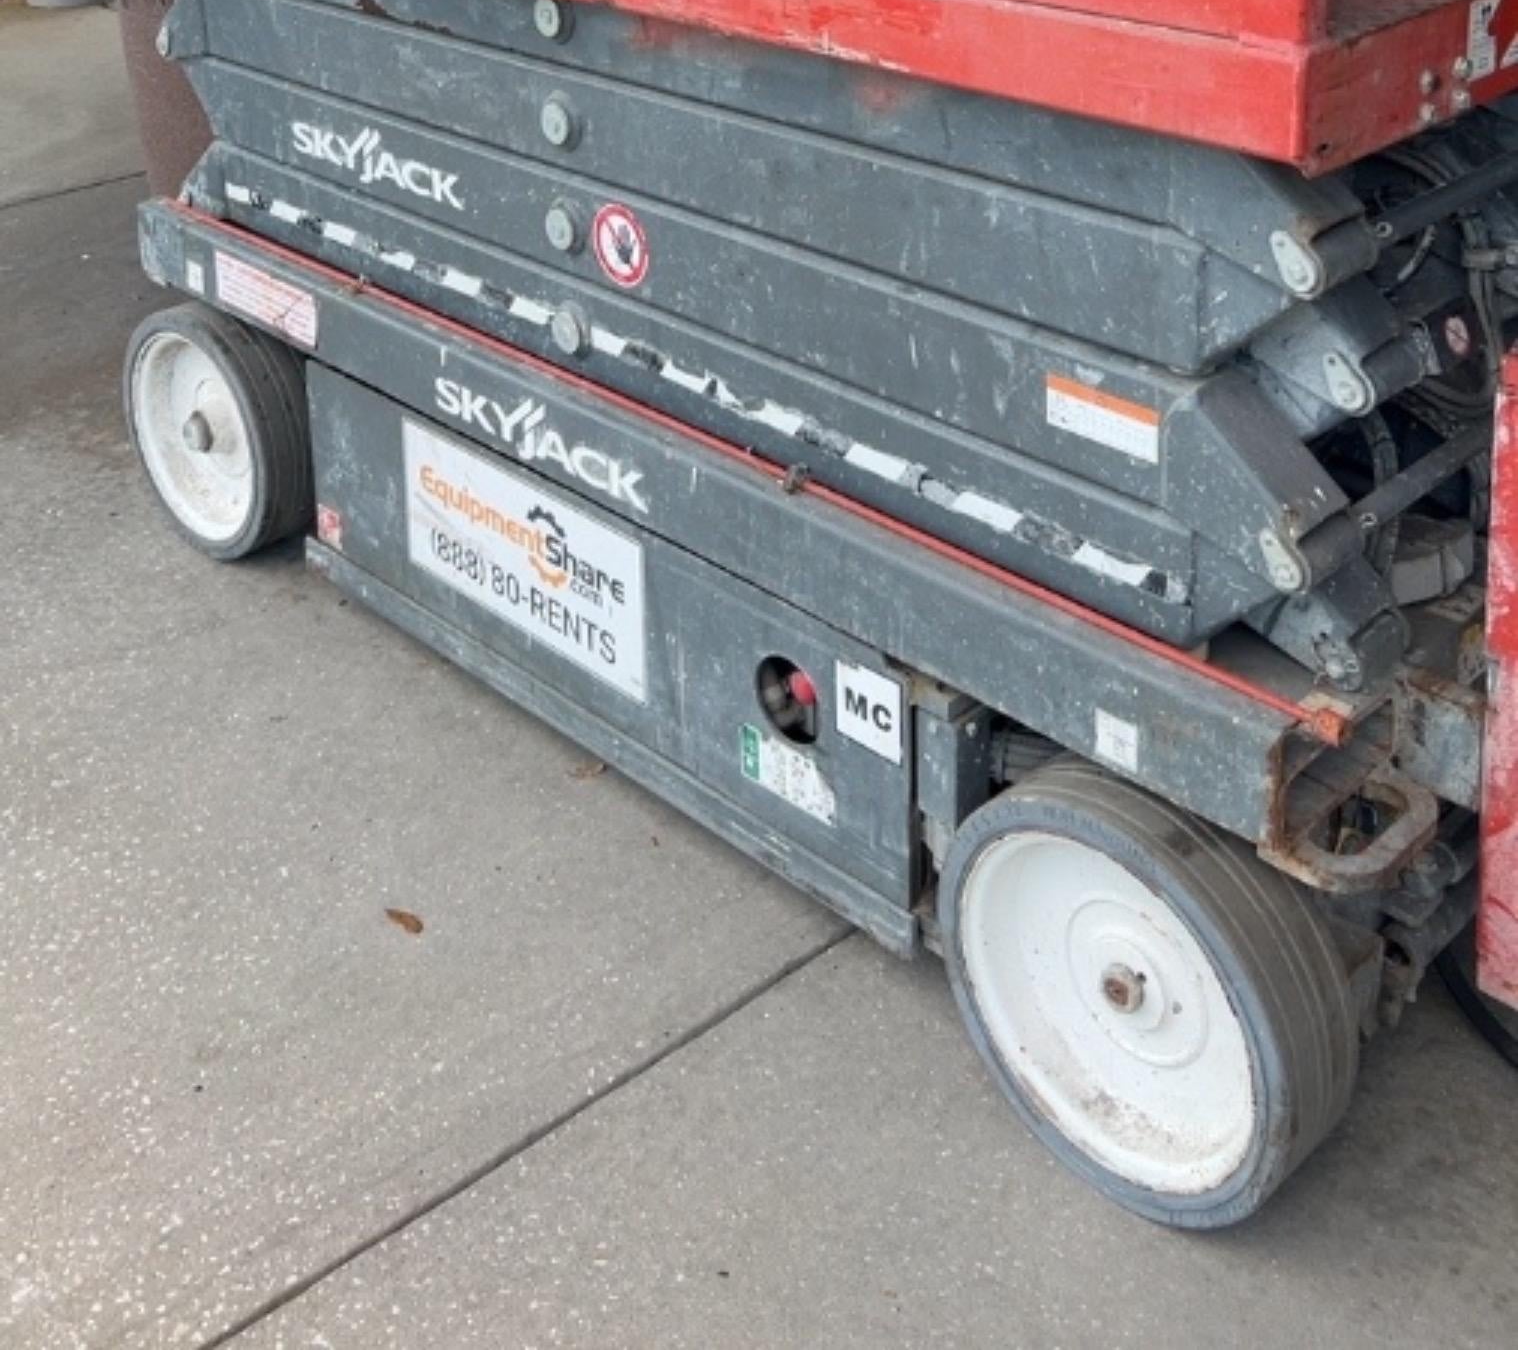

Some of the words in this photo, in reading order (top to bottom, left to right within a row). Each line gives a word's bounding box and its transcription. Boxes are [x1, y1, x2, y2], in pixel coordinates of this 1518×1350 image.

[291, 121, 465, 211] SKYJACK
[434, 377, 649, 515] SKYJACK
[431, 525, 487, 590] (888)
[491, 566, 617, 665] 80-RENTS
[845, 685, 892, 732] MC
